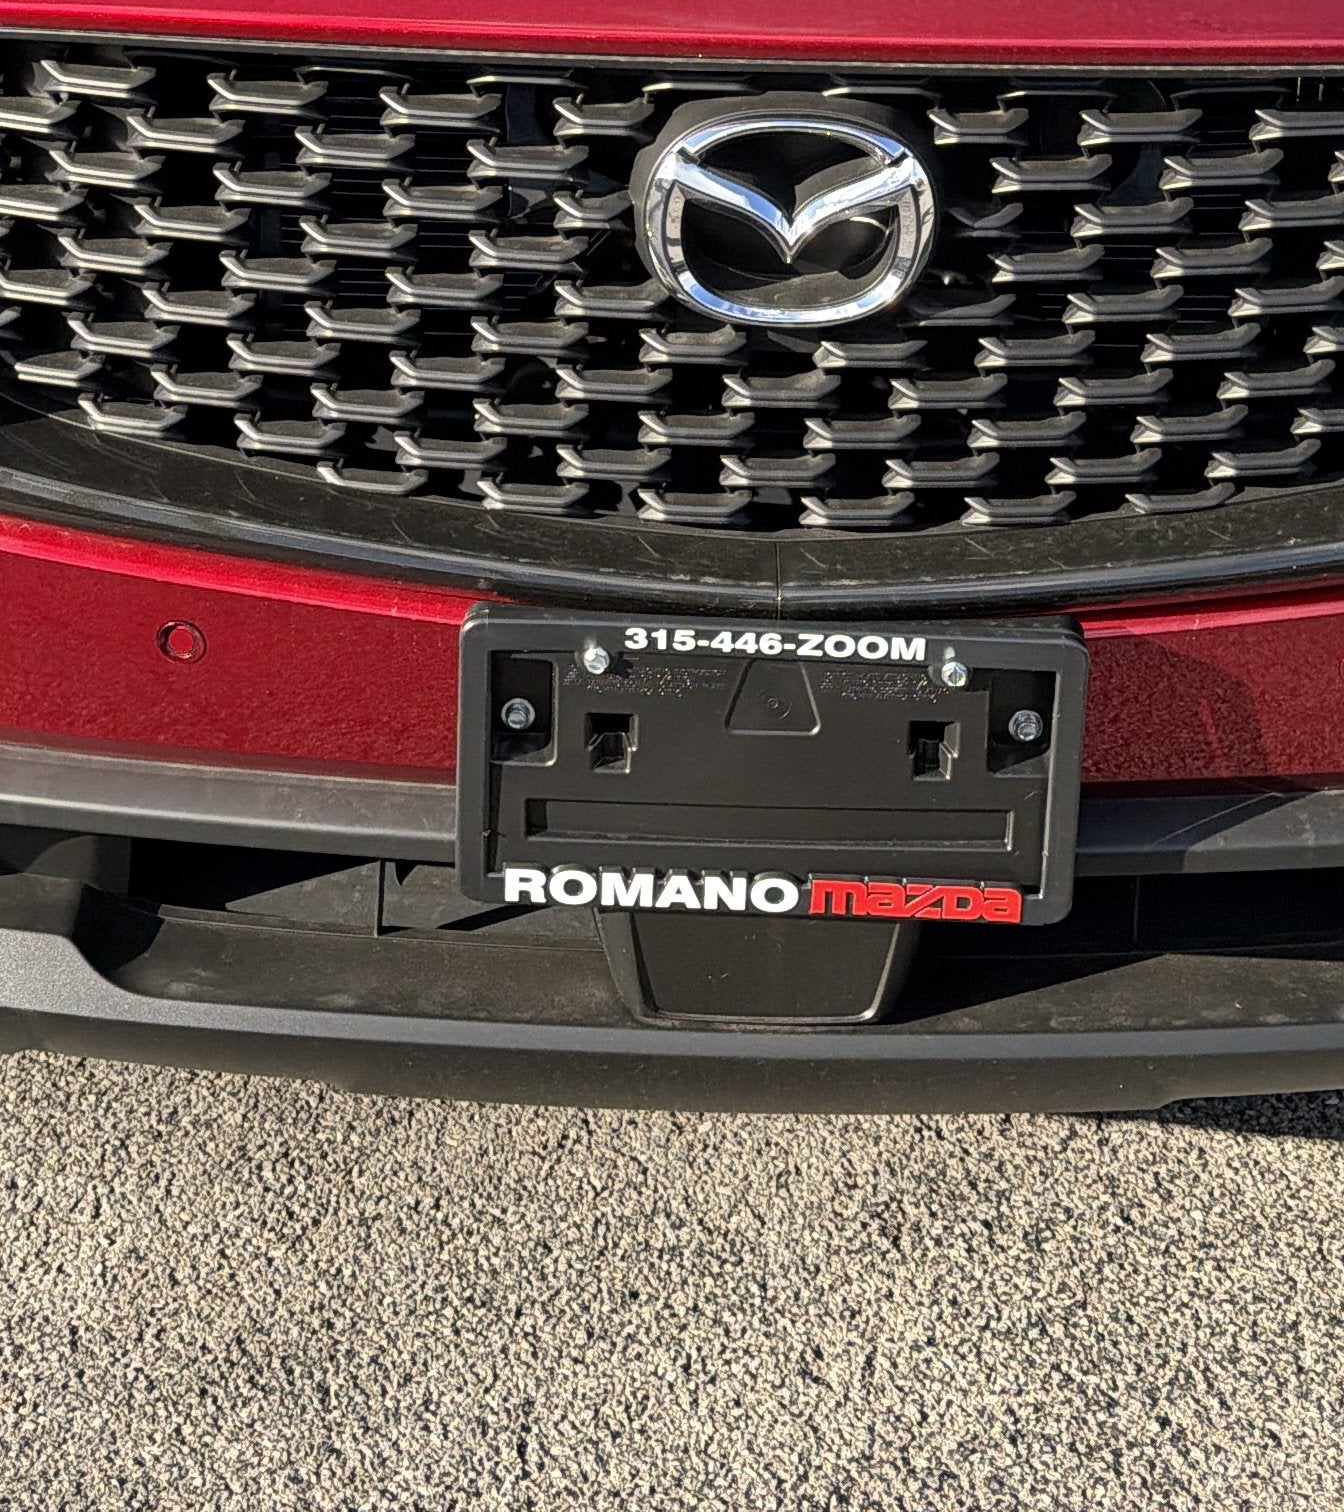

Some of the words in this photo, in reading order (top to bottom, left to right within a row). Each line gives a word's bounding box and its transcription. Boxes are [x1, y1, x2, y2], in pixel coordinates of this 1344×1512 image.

[624, 628, 926, 661] 315-446-ZOOM
[504, 868, 799, 913] ROMANO
[808, 879, 1023, 924] mazda
